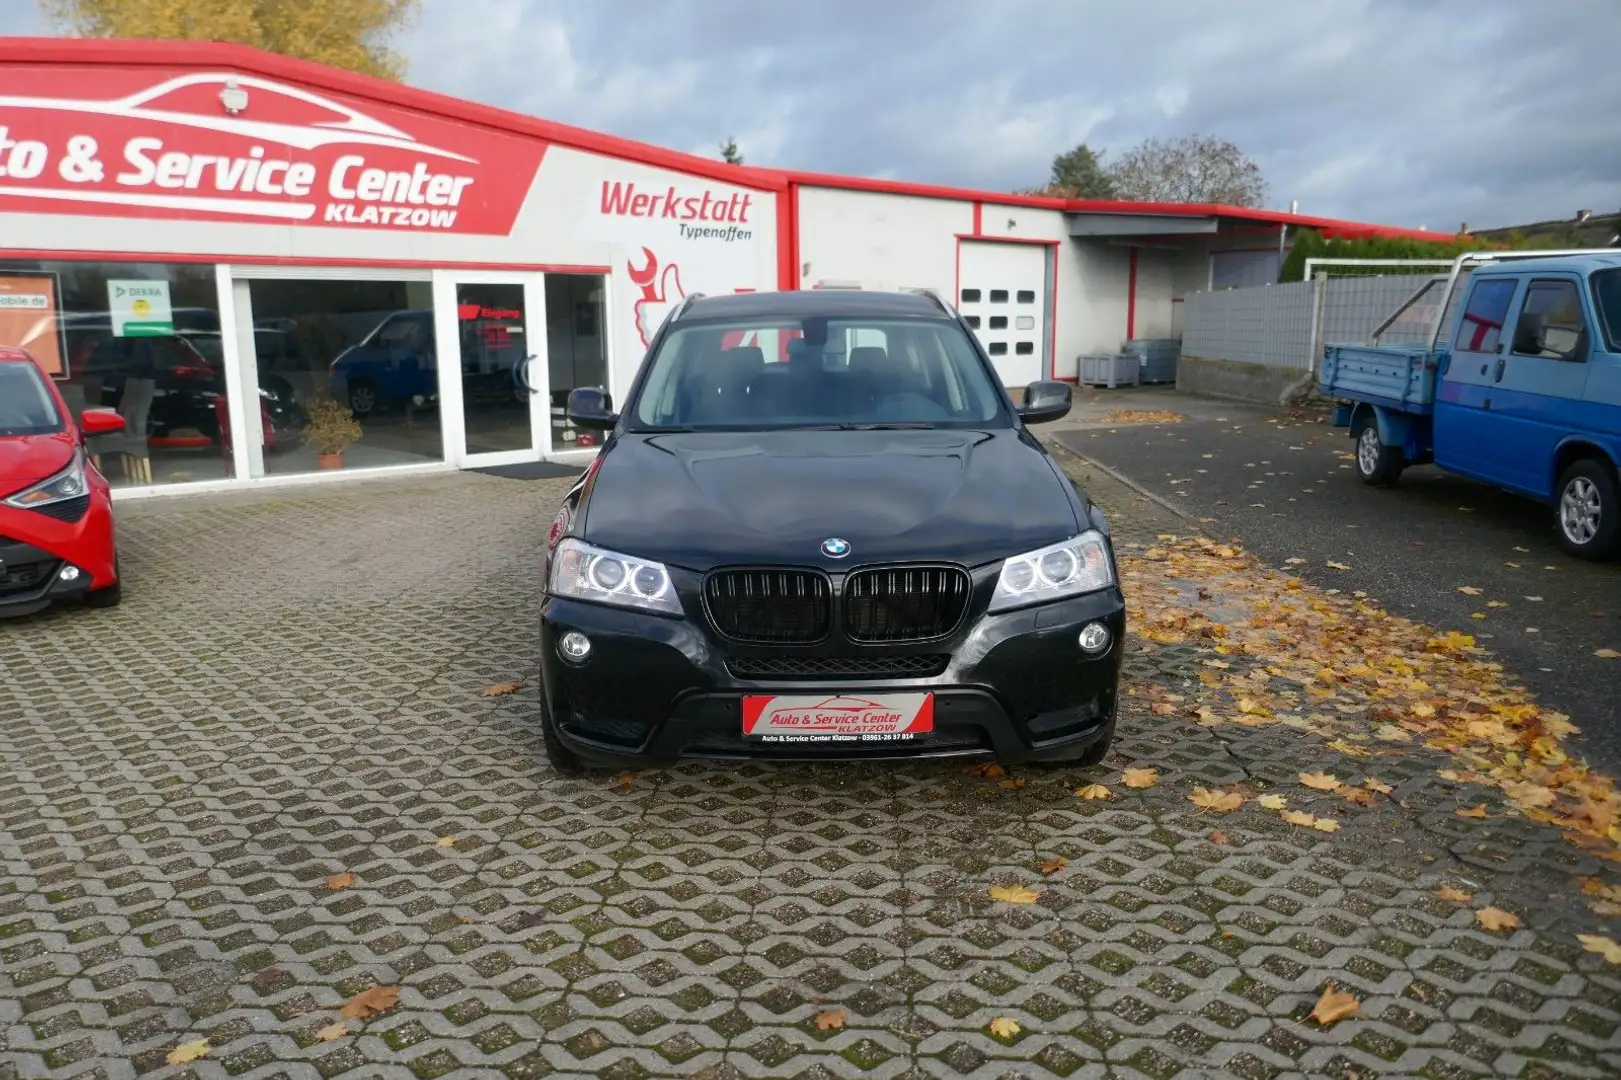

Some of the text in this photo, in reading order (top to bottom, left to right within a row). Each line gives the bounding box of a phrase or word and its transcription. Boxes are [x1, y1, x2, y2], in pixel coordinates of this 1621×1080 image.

[59, 134, 105, 183] &
[116, 136, 316, 196] Service
[328, 155, 475, 206] Center
[600, 181, 752, 223] Werkstatt
[324, 203, 458, 228] KLATZOW
[679, 223, 752, 242] Typenoffen
[481, 307, 521, 320] Eingang
[770, 712, 902, 725] Auto & Service Center
[838, 724, 896, 733] KLATZOW
